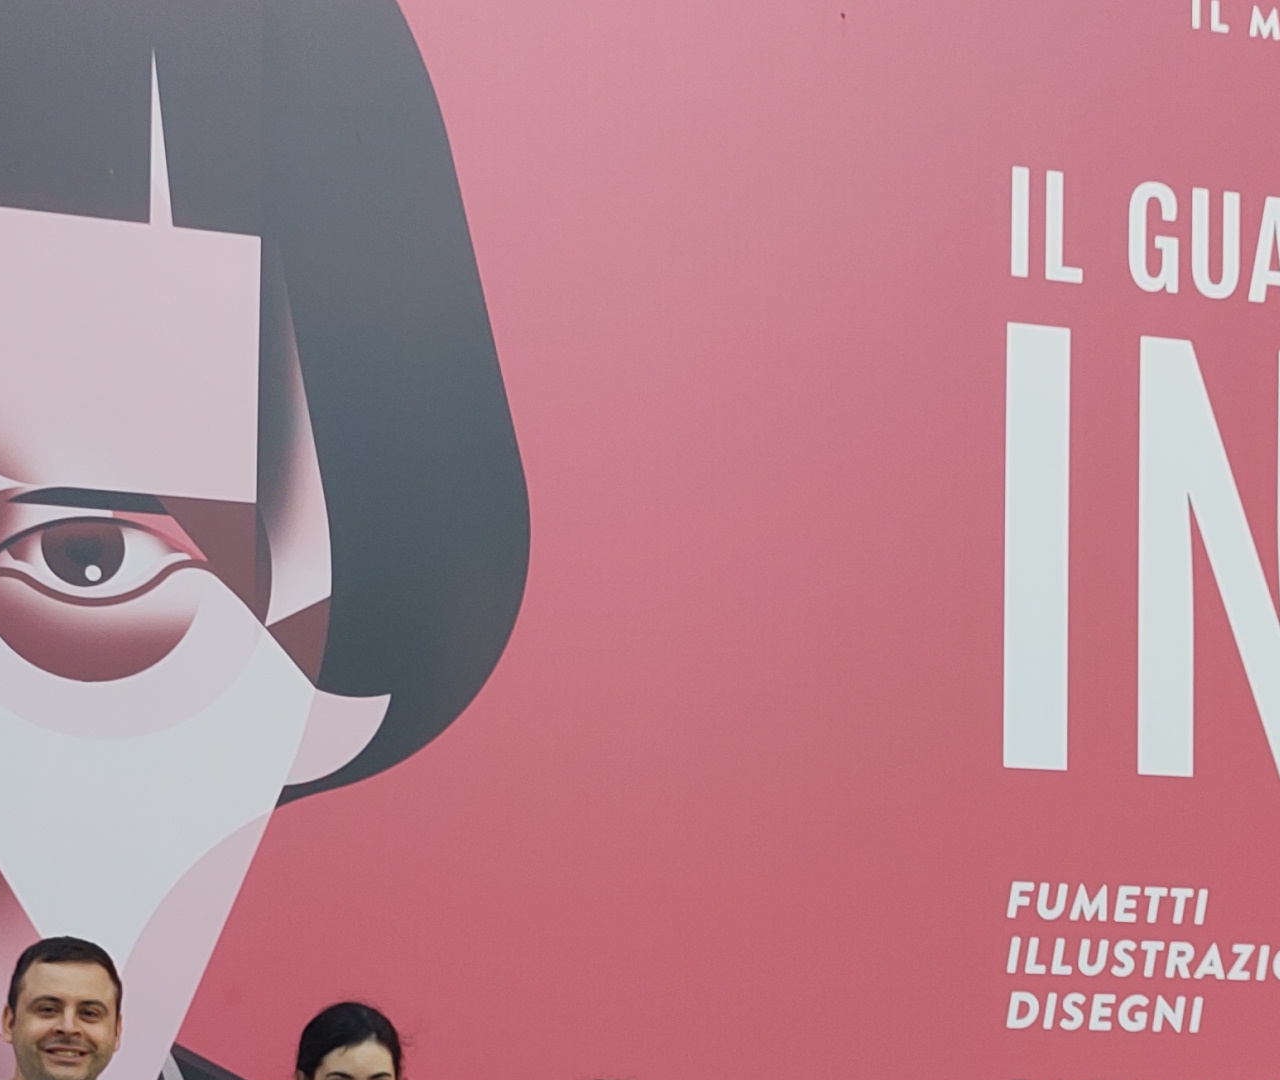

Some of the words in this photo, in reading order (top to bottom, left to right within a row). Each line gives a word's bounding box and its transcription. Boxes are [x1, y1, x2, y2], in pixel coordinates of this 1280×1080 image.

[1191, 0, 1230, 34] IL
[1010, 165, 1084, 284] IL
[1006, 881, 1209, 926] FUMETTI
[1006, 991, 1204, 1034] DISEGNI
